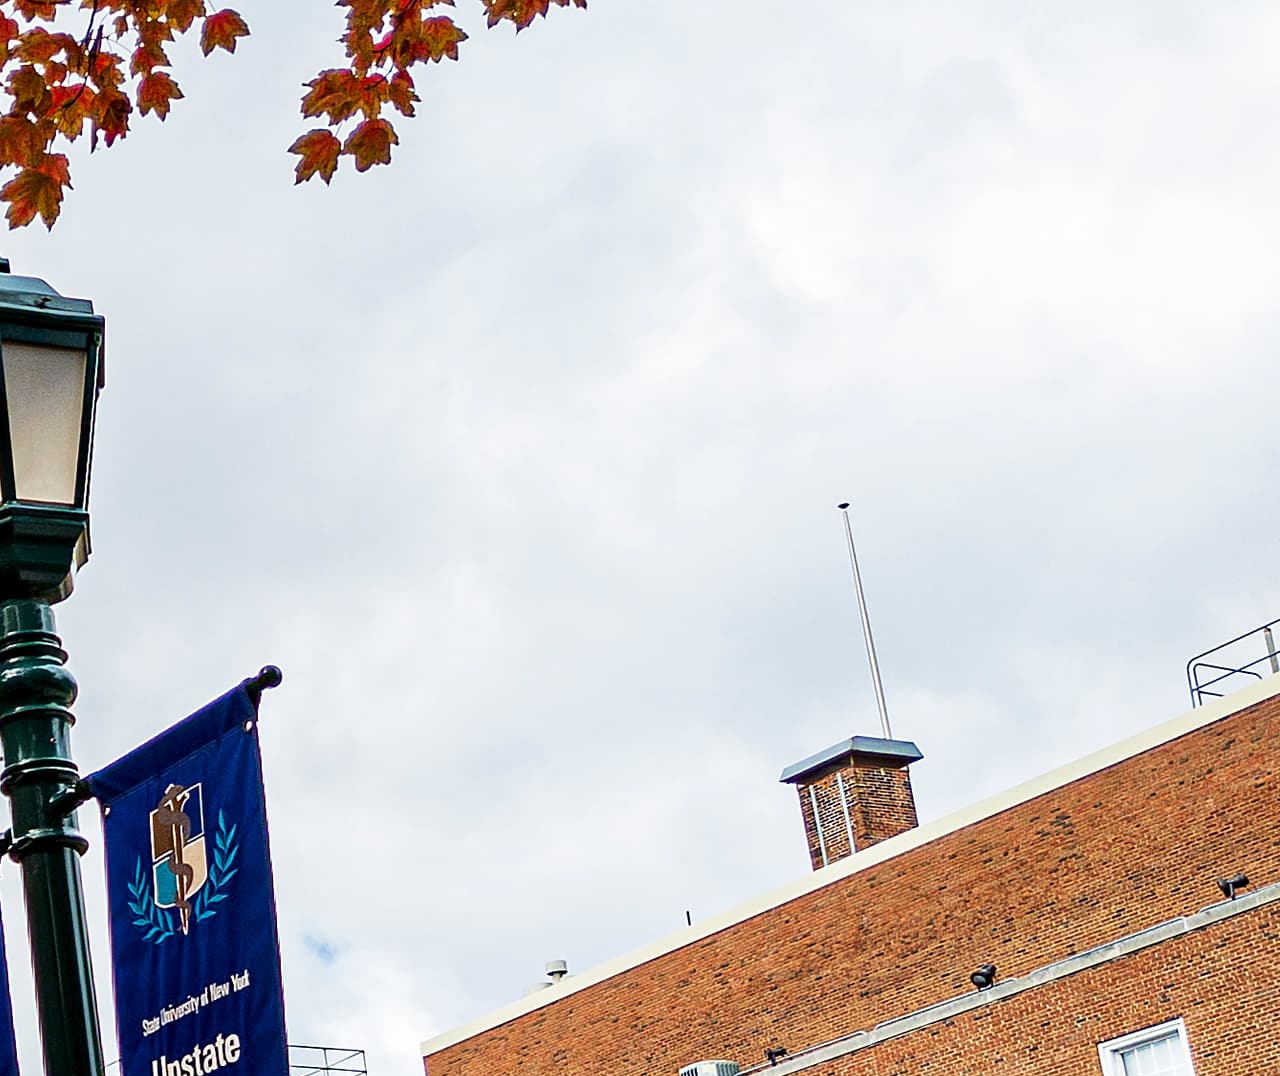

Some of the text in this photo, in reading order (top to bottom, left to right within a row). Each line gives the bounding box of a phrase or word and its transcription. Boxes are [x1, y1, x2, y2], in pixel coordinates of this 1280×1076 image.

[142, 969, 251, 1037] State University of New York
